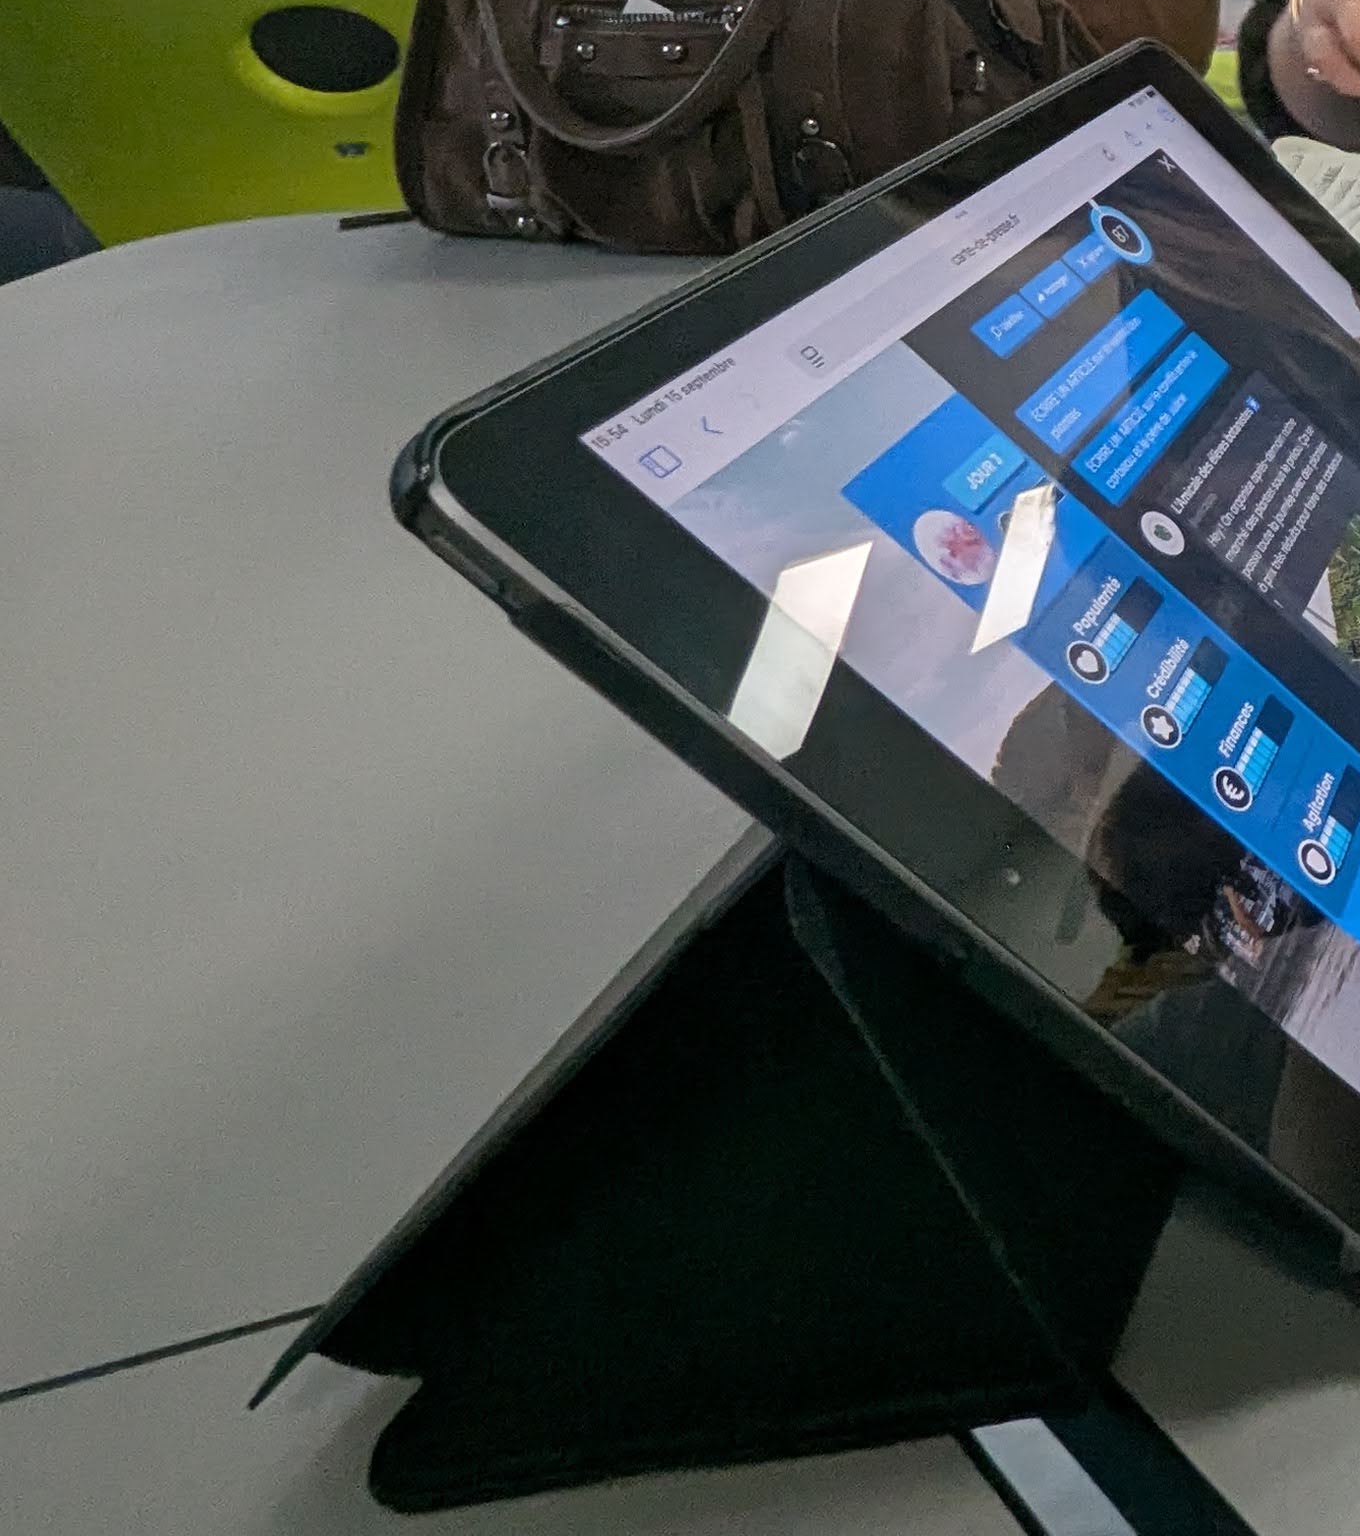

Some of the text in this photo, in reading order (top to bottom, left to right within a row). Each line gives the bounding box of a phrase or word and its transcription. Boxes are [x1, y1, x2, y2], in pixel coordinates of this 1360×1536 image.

[1112, 225, 1129, 241] 87
[632, 399, 667, 423] Lundi
[665, 391, 681, 402] 15
[680, 357, 736, 395] septembre
[964, 460, 996, 490] JOUR
[1169, 472, 1204, 514] L'Amicale
[1195, 458, 1214, 479] des
[1205, 436, 1230, 466] élèves
[1222, 404, 1254, 444] botanistes
[1243, 512, 1259, 532] des
[1072, 575, 1122, 637] Popularité
[1145, 637, 1187, 698] Crédibilité
[1218, 699, 1252, 756] Finances
[1301, 769, 1335, 834] Agitation
